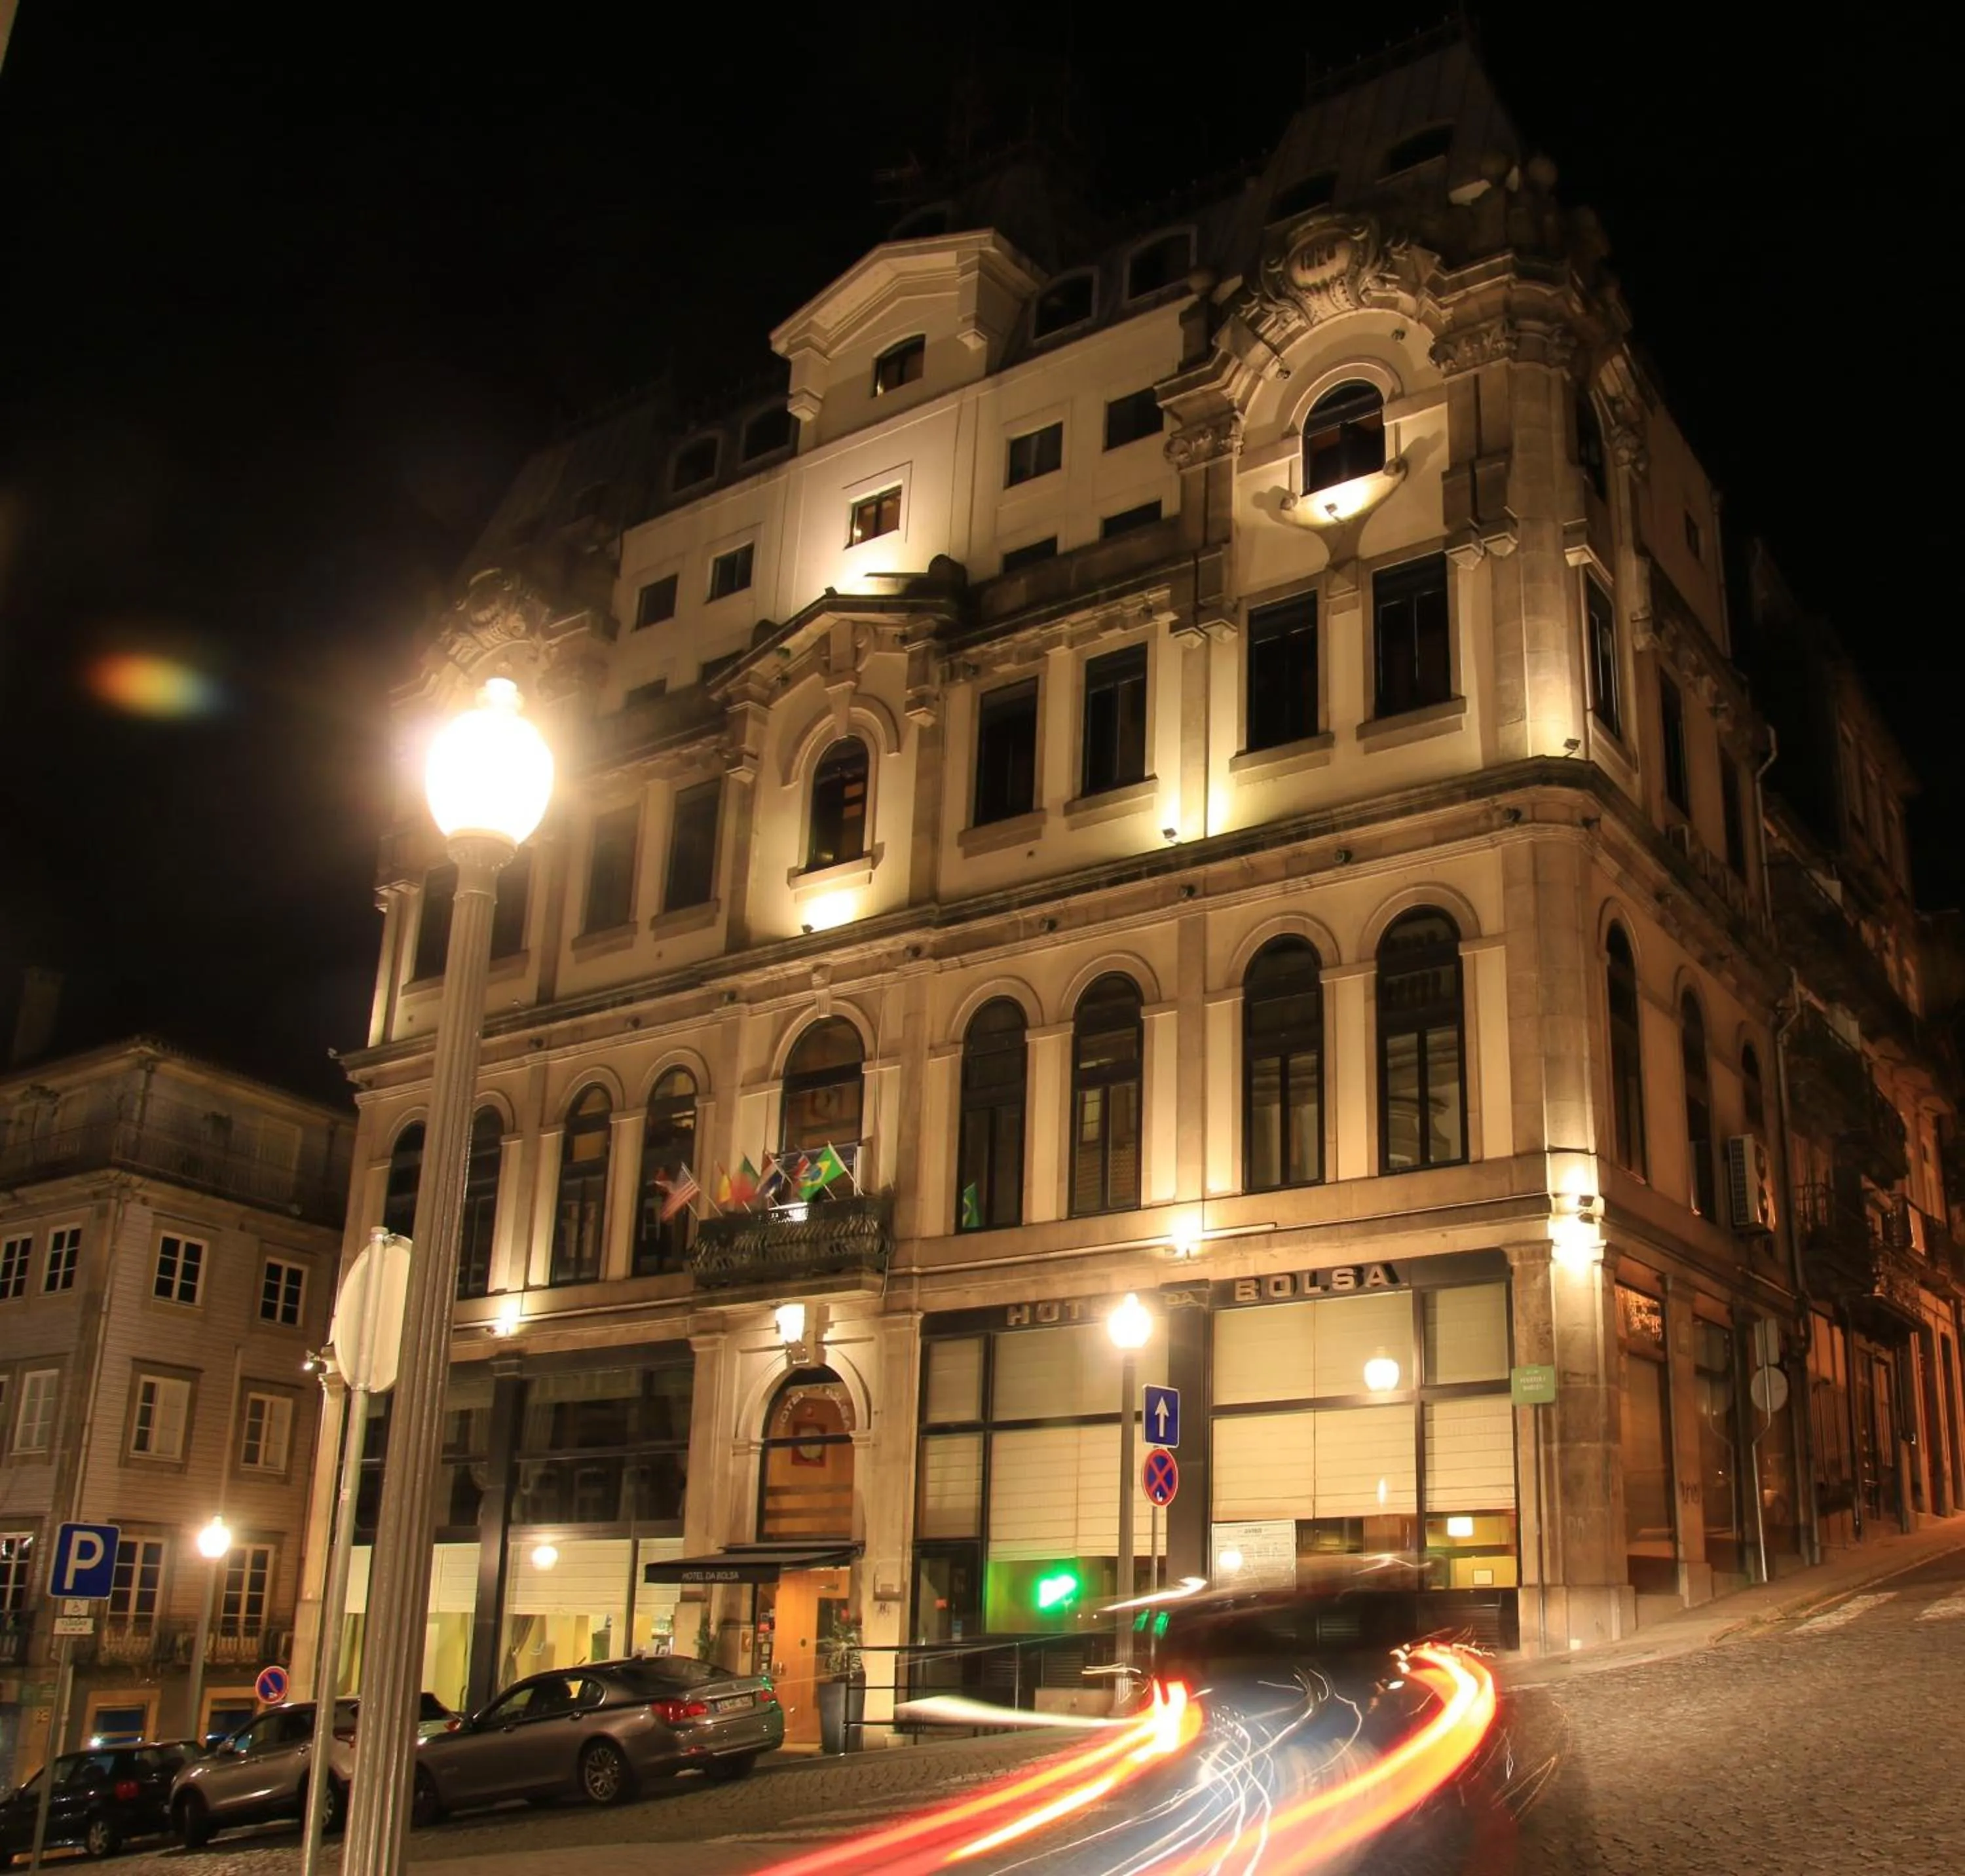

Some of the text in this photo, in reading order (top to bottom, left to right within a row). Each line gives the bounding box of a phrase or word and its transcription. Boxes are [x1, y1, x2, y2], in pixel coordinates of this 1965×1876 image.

[1006, 1298, 1085, 1327] HOT
[1235, 1264, 1398, 1302] BOLSA
[64, 1531, 104, 1590] P
[682, 1571, 703, 1581] HOTEL
